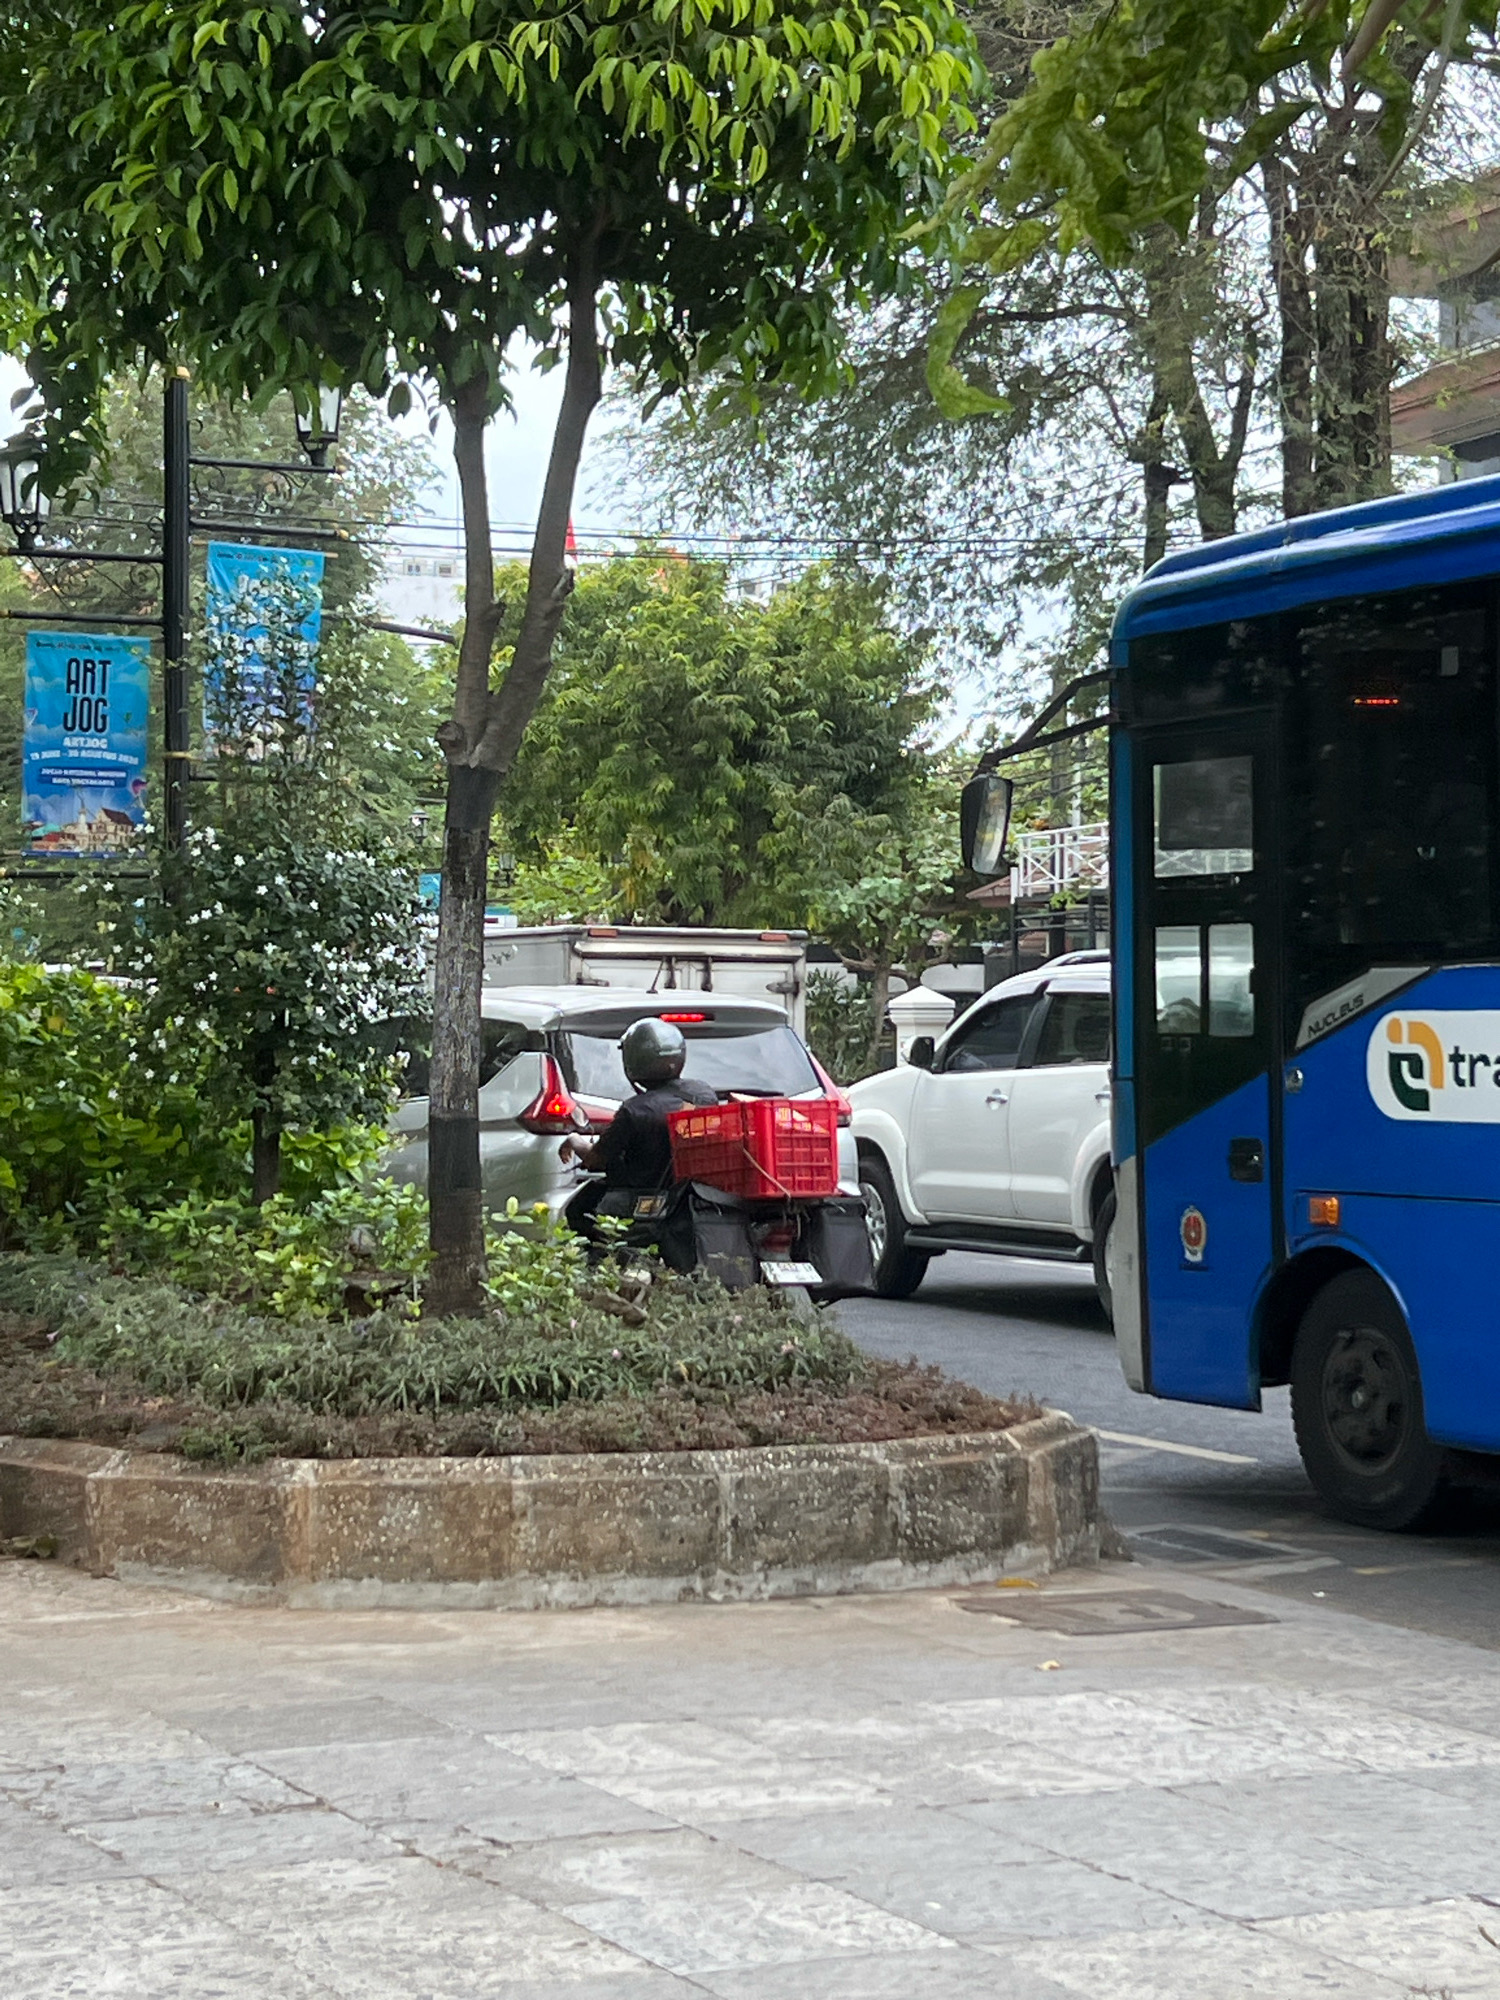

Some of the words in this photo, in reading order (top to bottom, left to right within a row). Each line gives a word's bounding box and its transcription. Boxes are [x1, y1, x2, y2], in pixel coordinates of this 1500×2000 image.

[66, 657, 112, 695] ART
[63, 696, 109, 733] JOG
[63, 736, 108, 749] ARTJOG
[1307, 993, 1364, 1039] NUCLEUS
